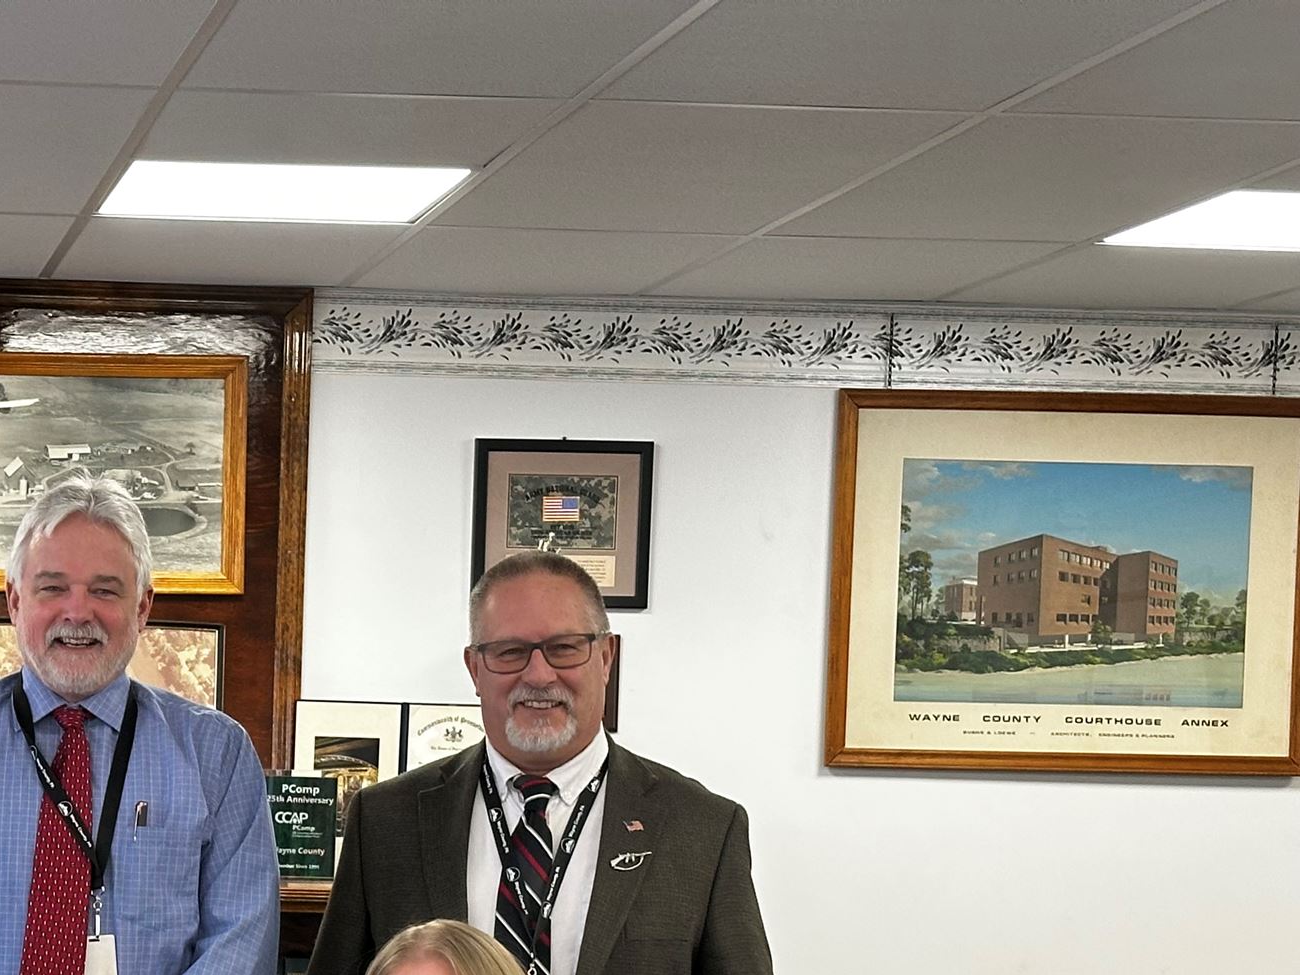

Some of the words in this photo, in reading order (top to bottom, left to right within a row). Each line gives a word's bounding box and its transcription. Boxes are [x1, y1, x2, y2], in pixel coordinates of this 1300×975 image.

[909, 714, 960, 722] WAYNE
[982, 715, 1041, 723] COUNTY
[1065, 716, 1162, 726] COURTHOUSE
[1181, 719, 1229, 727] ANNEX
[282, 784, 319, 796] PComp
[286, 795, 334, 806] Anniversary
[275, 812, 308, 823] CCAP
[298, 847, 325, 856] County
